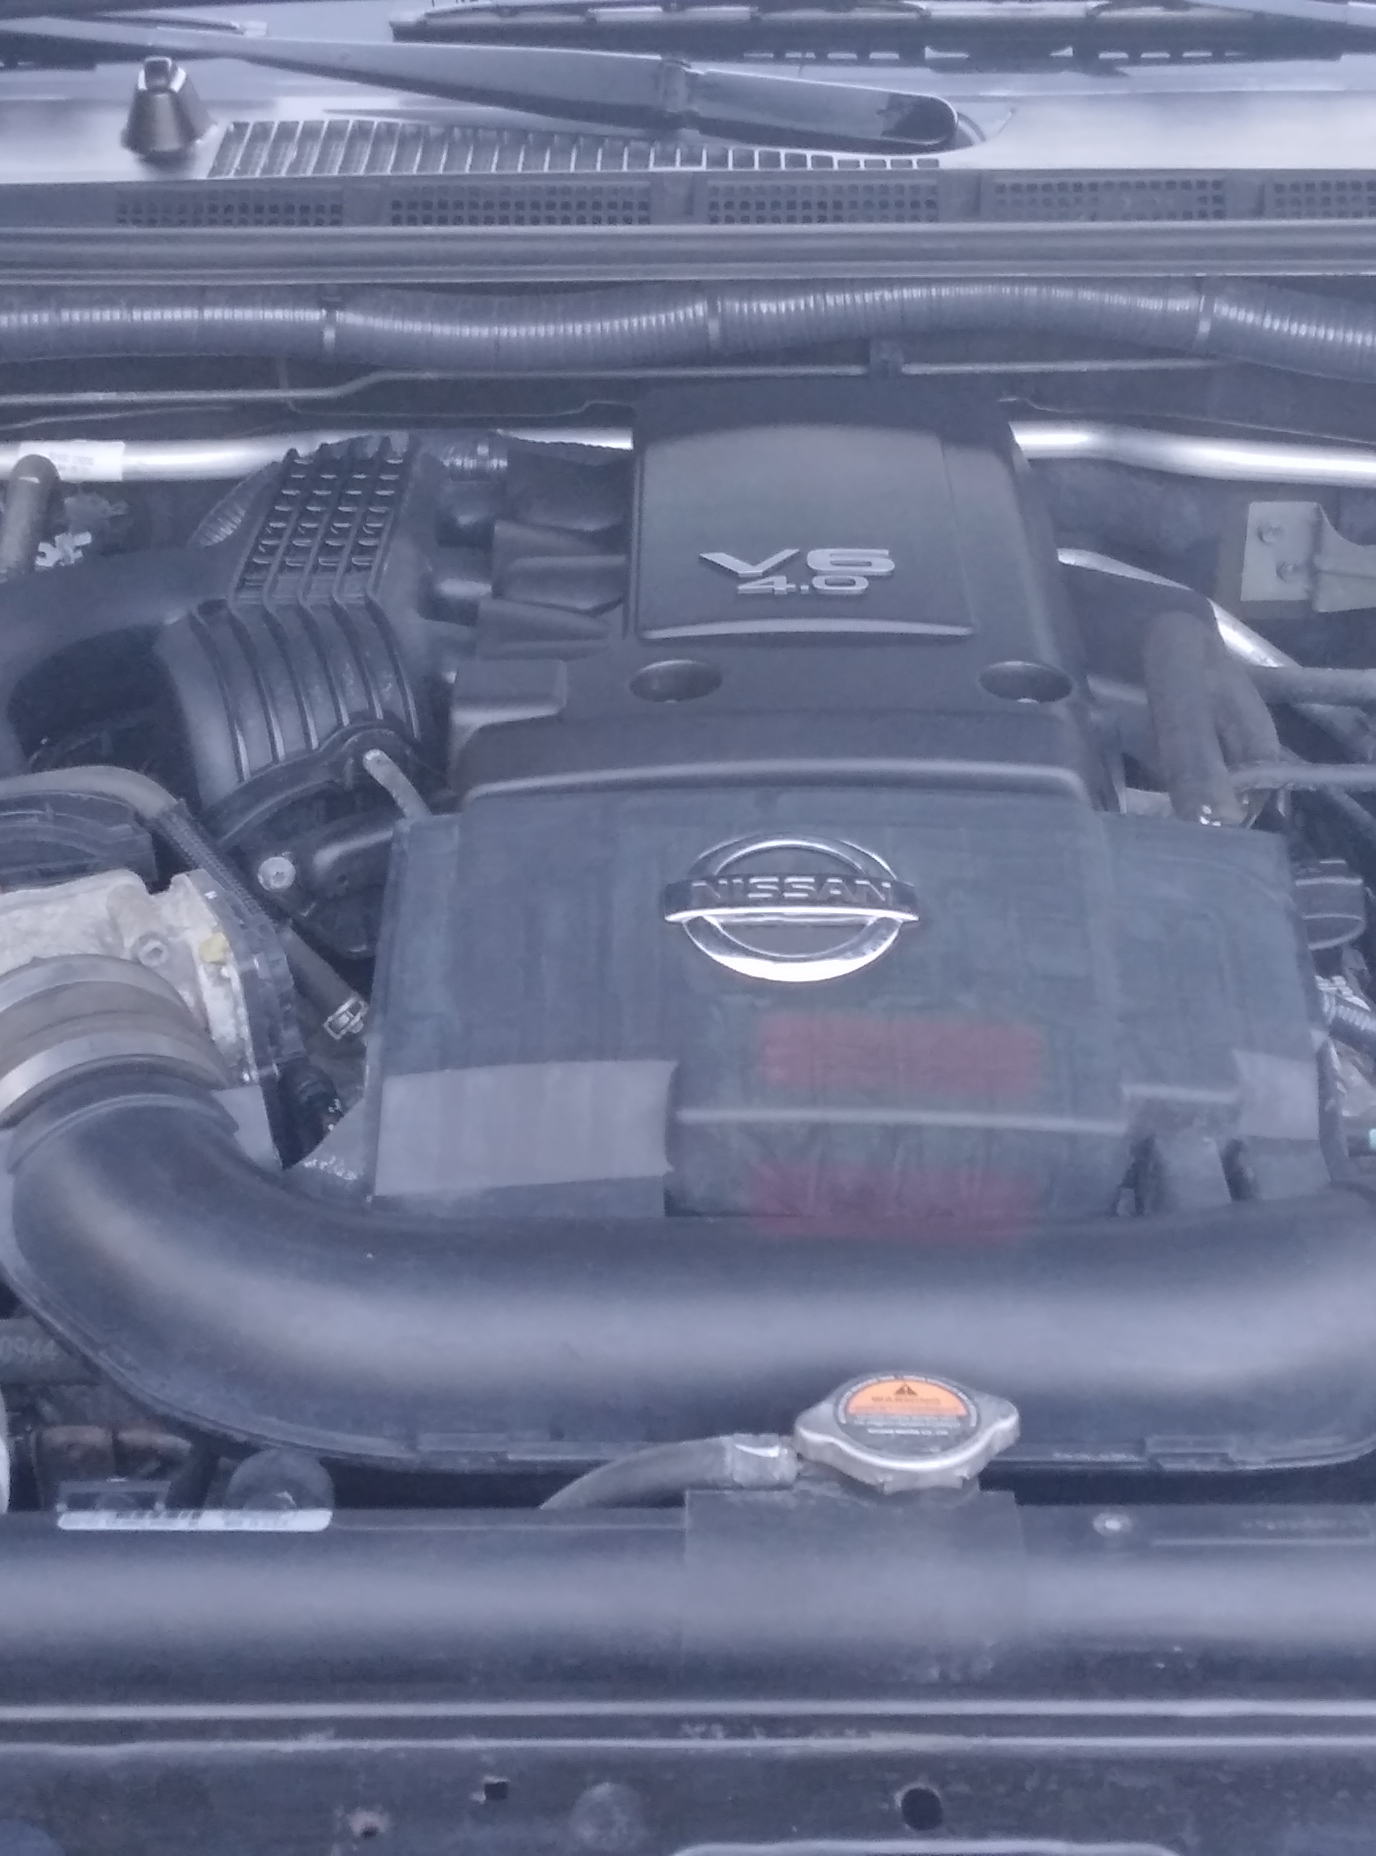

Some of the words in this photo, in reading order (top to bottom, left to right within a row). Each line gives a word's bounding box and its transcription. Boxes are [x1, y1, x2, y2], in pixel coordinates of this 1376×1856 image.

[698, 548, 896, 578] V6
[737, 575, 870, 595] 4.0
[691, 877, 892, 904] NISSAN
